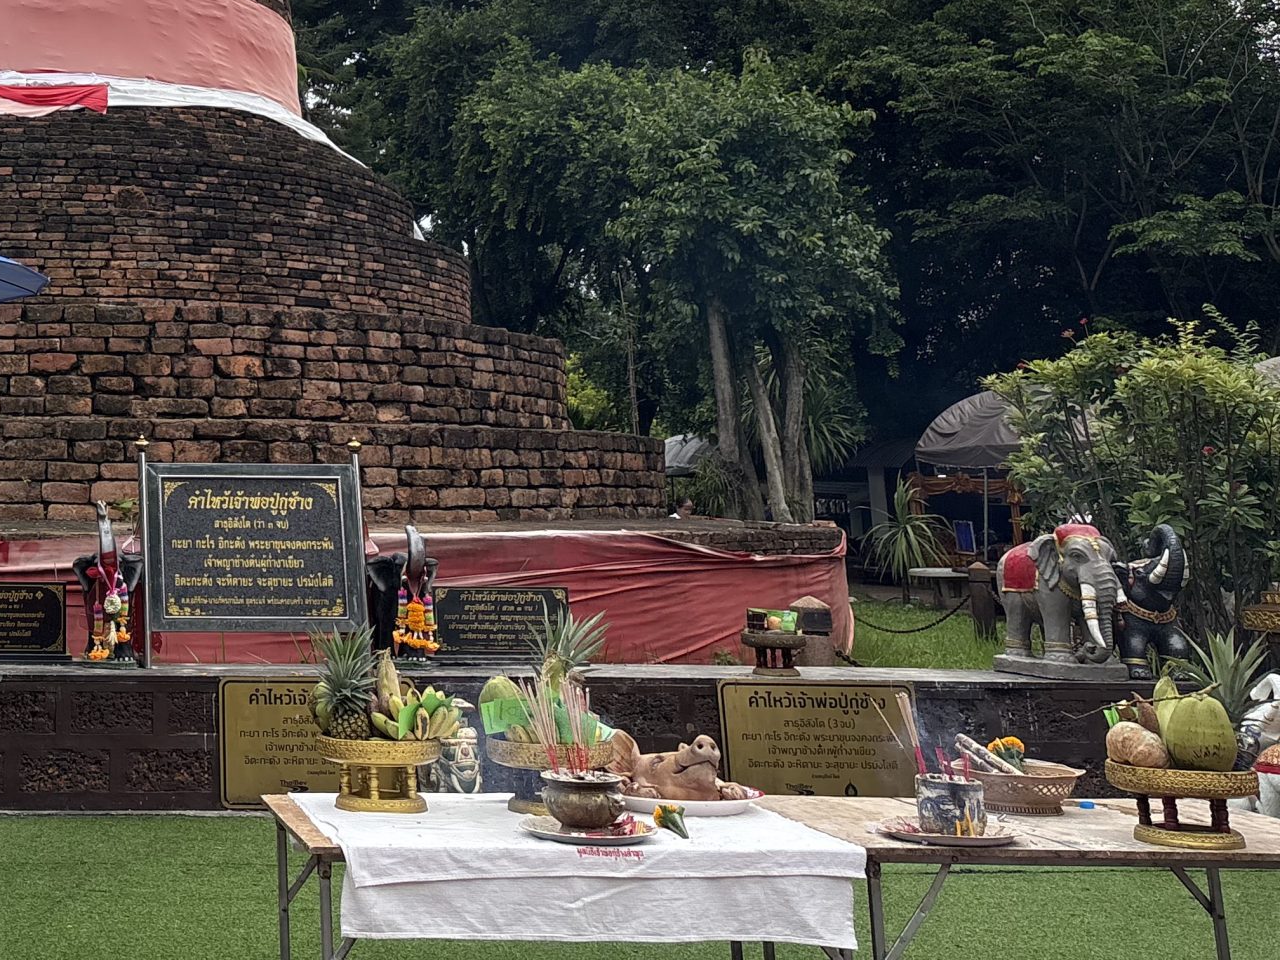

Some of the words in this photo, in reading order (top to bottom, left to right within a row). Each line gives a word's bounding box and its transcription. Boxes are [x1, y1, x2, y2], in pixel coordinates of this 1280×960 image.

[187, 490, 313, 516] คำไหว้เจ้าพ่อปู่กู่ช้าง
[748, 691, 886, 716] คำไหว้เจ้าพ่อปู่กู่ช้าง
